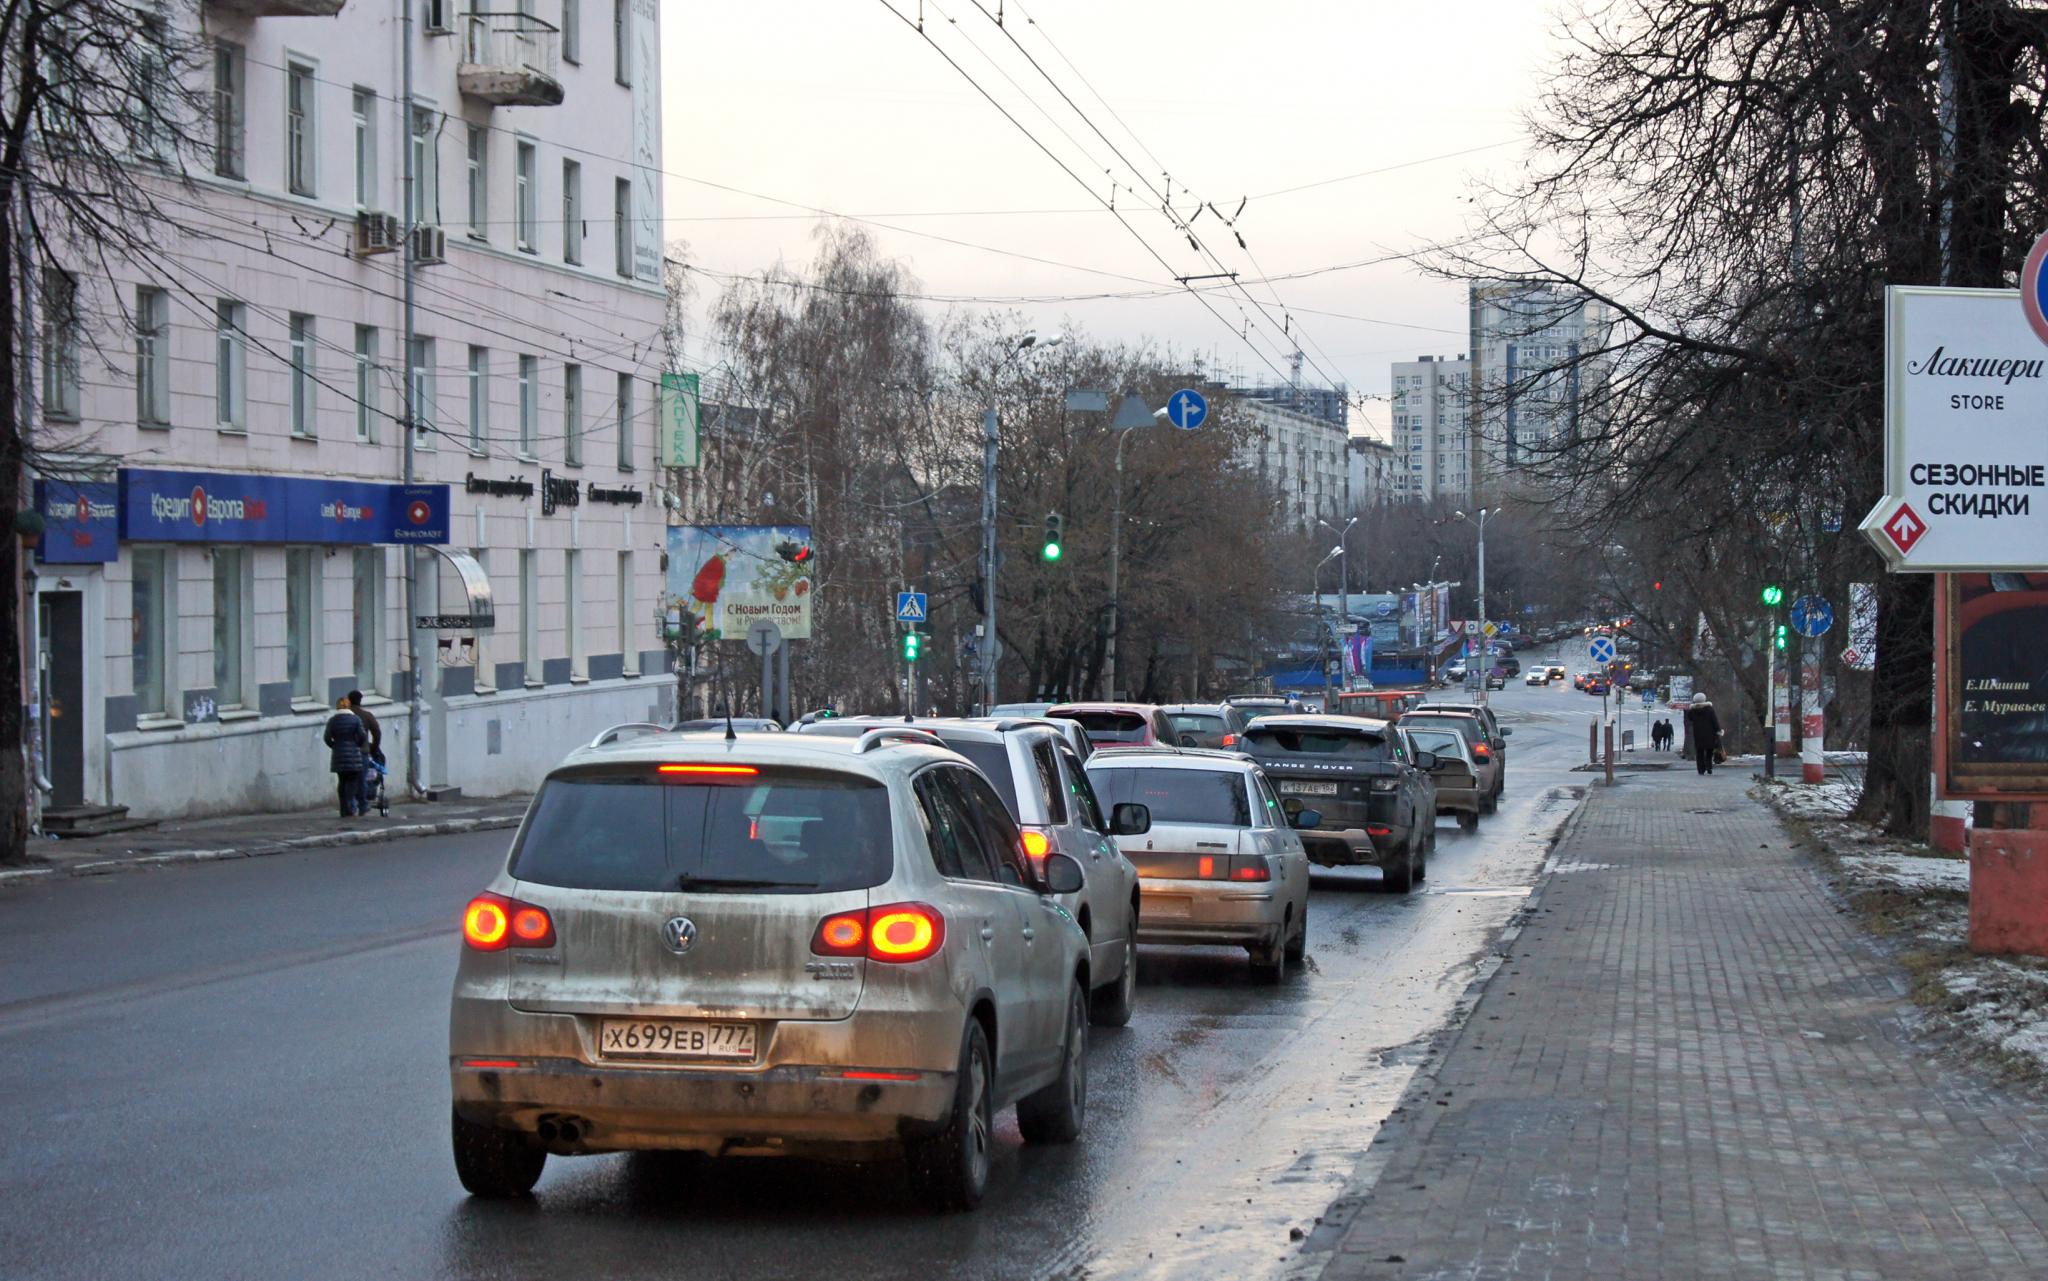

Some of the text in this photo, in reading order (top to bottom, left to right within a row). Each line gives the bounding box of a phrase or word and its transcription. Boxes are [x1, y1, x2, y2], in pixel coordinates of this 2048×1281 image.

[1907, 346, 2045, 386] Лакшери
[1950, 394, 2005, 411] STORE
[672, 392, 687, 465] АПТЕКА
[1909, 463, 2046, 487] СЕЗОННЫЕ
[1927, 492, 2030, 519] СКИДКИ
[727, 604, 735, 615] С
[1982, 700, 2047, 716] Муравьев
[711, 1024, 750, 1046] 777
